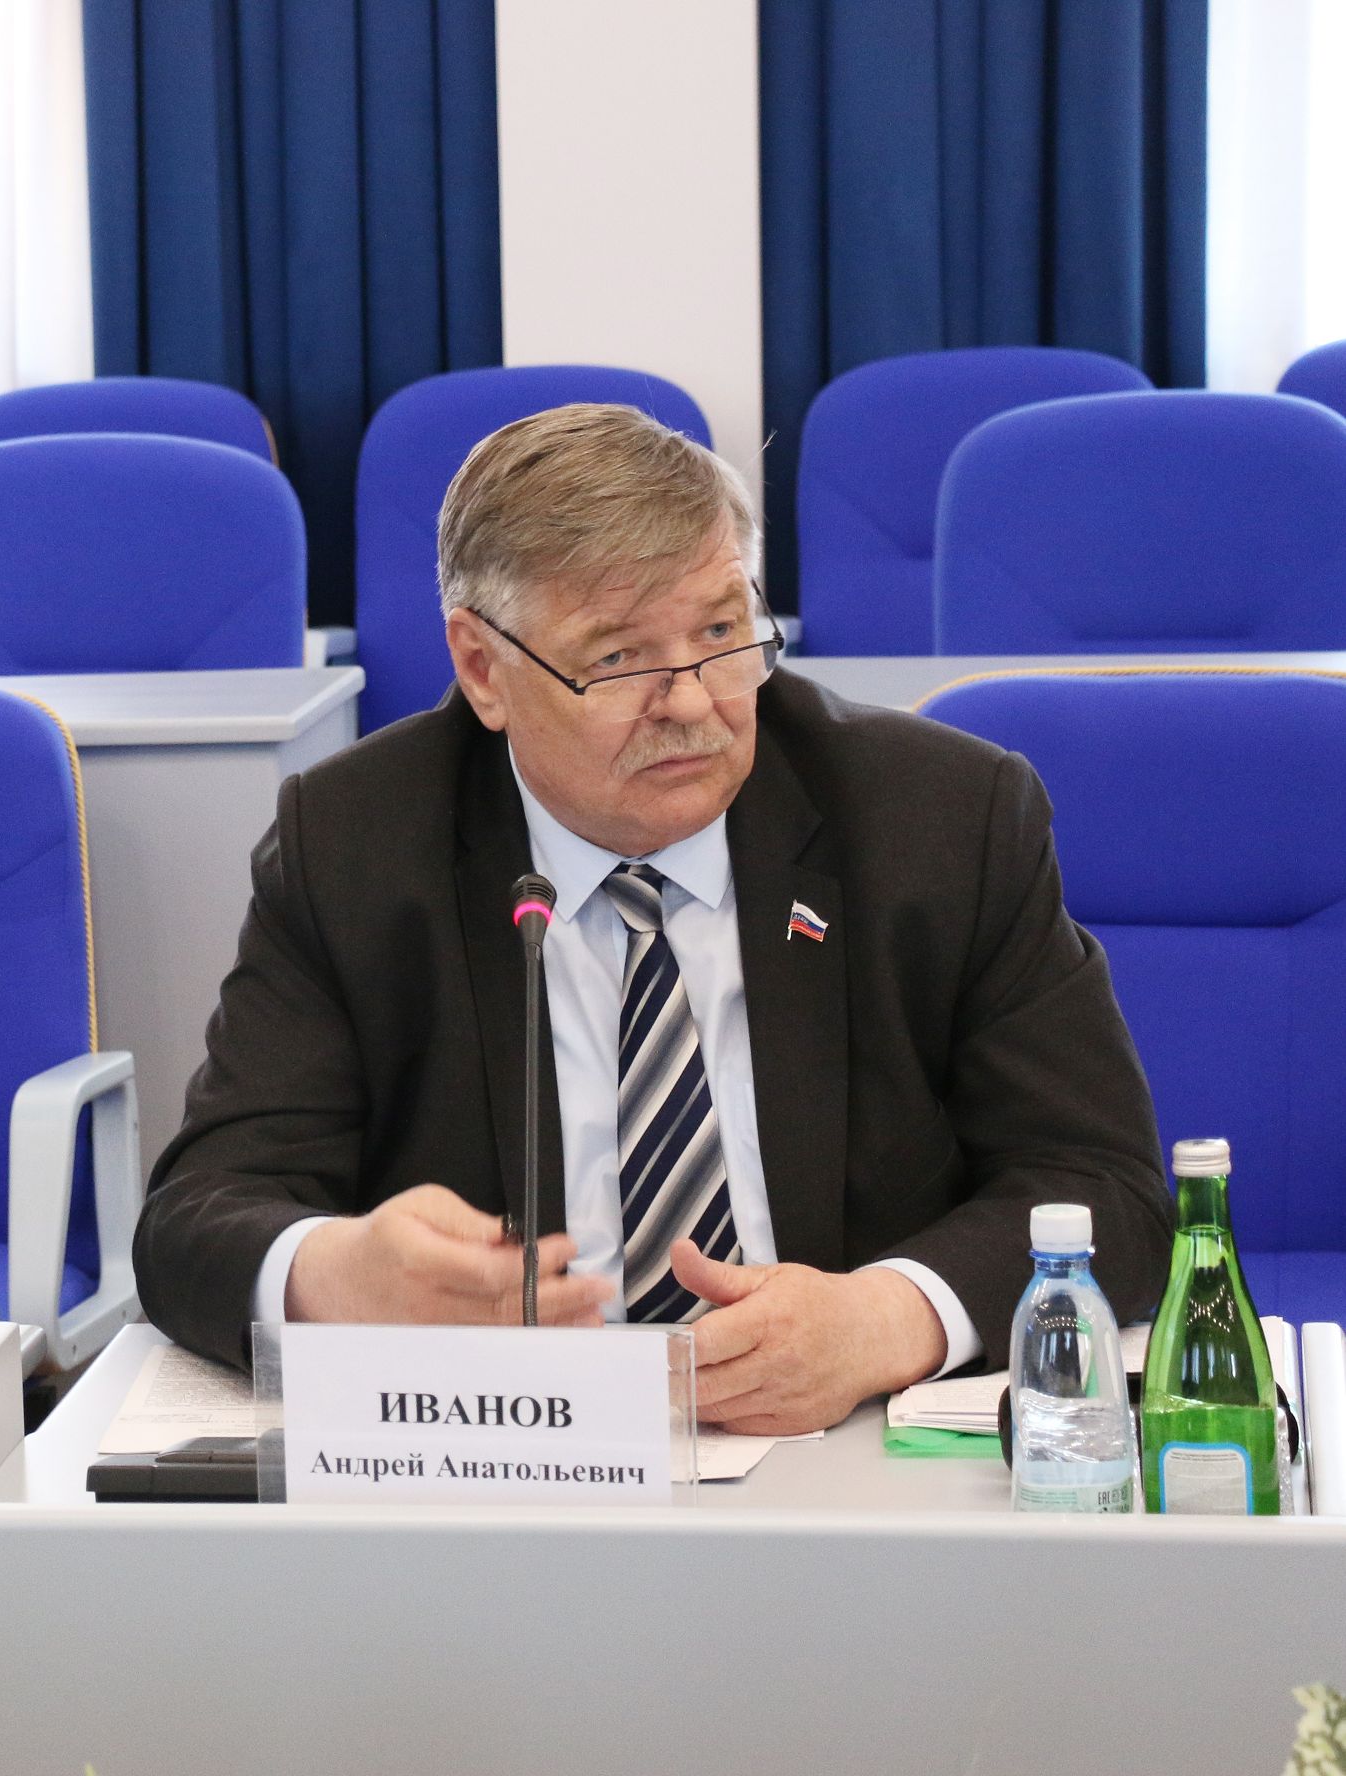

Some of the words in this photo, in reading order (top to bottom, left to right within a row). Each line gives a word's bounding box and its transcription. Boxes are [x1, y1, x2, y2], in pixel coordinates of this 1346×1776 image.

[379, 1392, 573, 1428] ИВАНОВ
[311, 1451, 424, 1482] Андрей
[437, 1454, 645, 1485] Анатольевич
